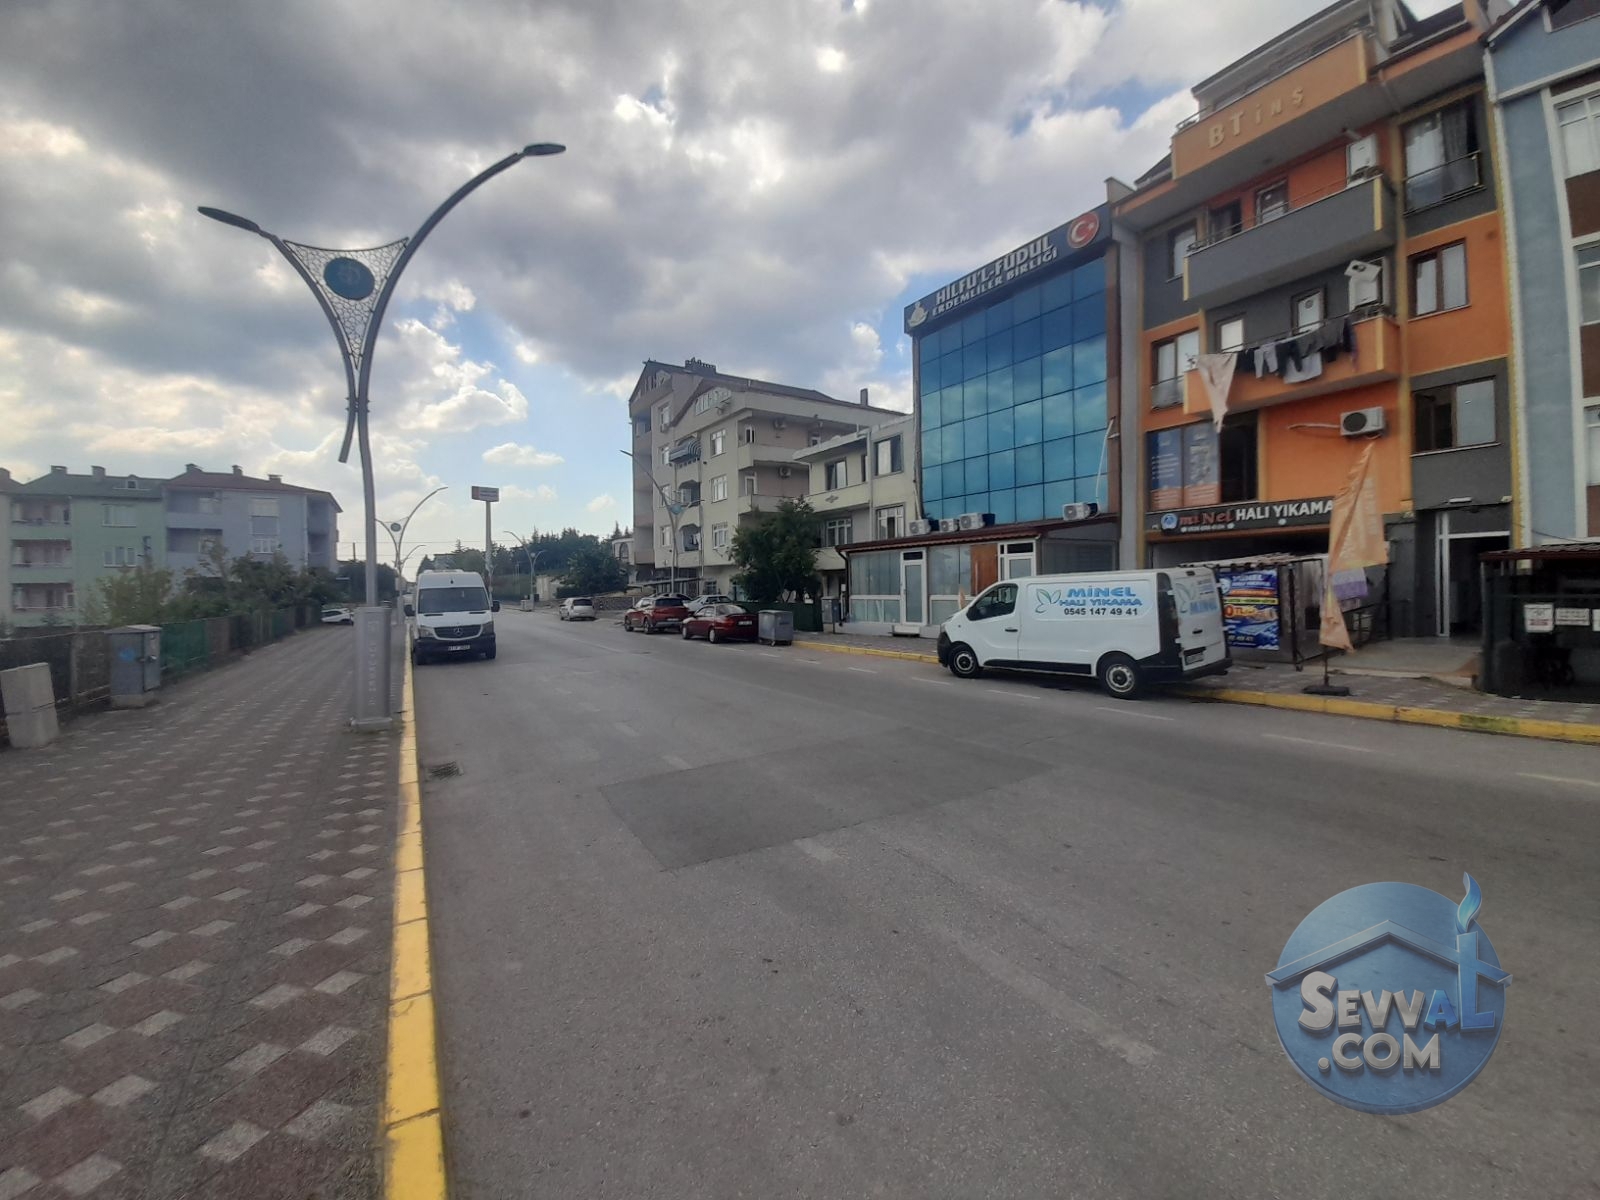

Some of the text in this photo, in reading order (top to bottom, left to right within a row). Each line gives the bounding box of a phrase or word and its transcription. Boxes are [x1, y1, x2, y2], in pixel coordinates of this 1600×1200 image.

[1235, 506, 1270, 521] HALI
[1273, 499, 1334, 518] YIKAMA
[1066, 585, 1137, 598] MİNEL
[1089, 598, 1144, 607] YIKAMA
[1063, 607, 1138, 616] 0545 147 49 41
